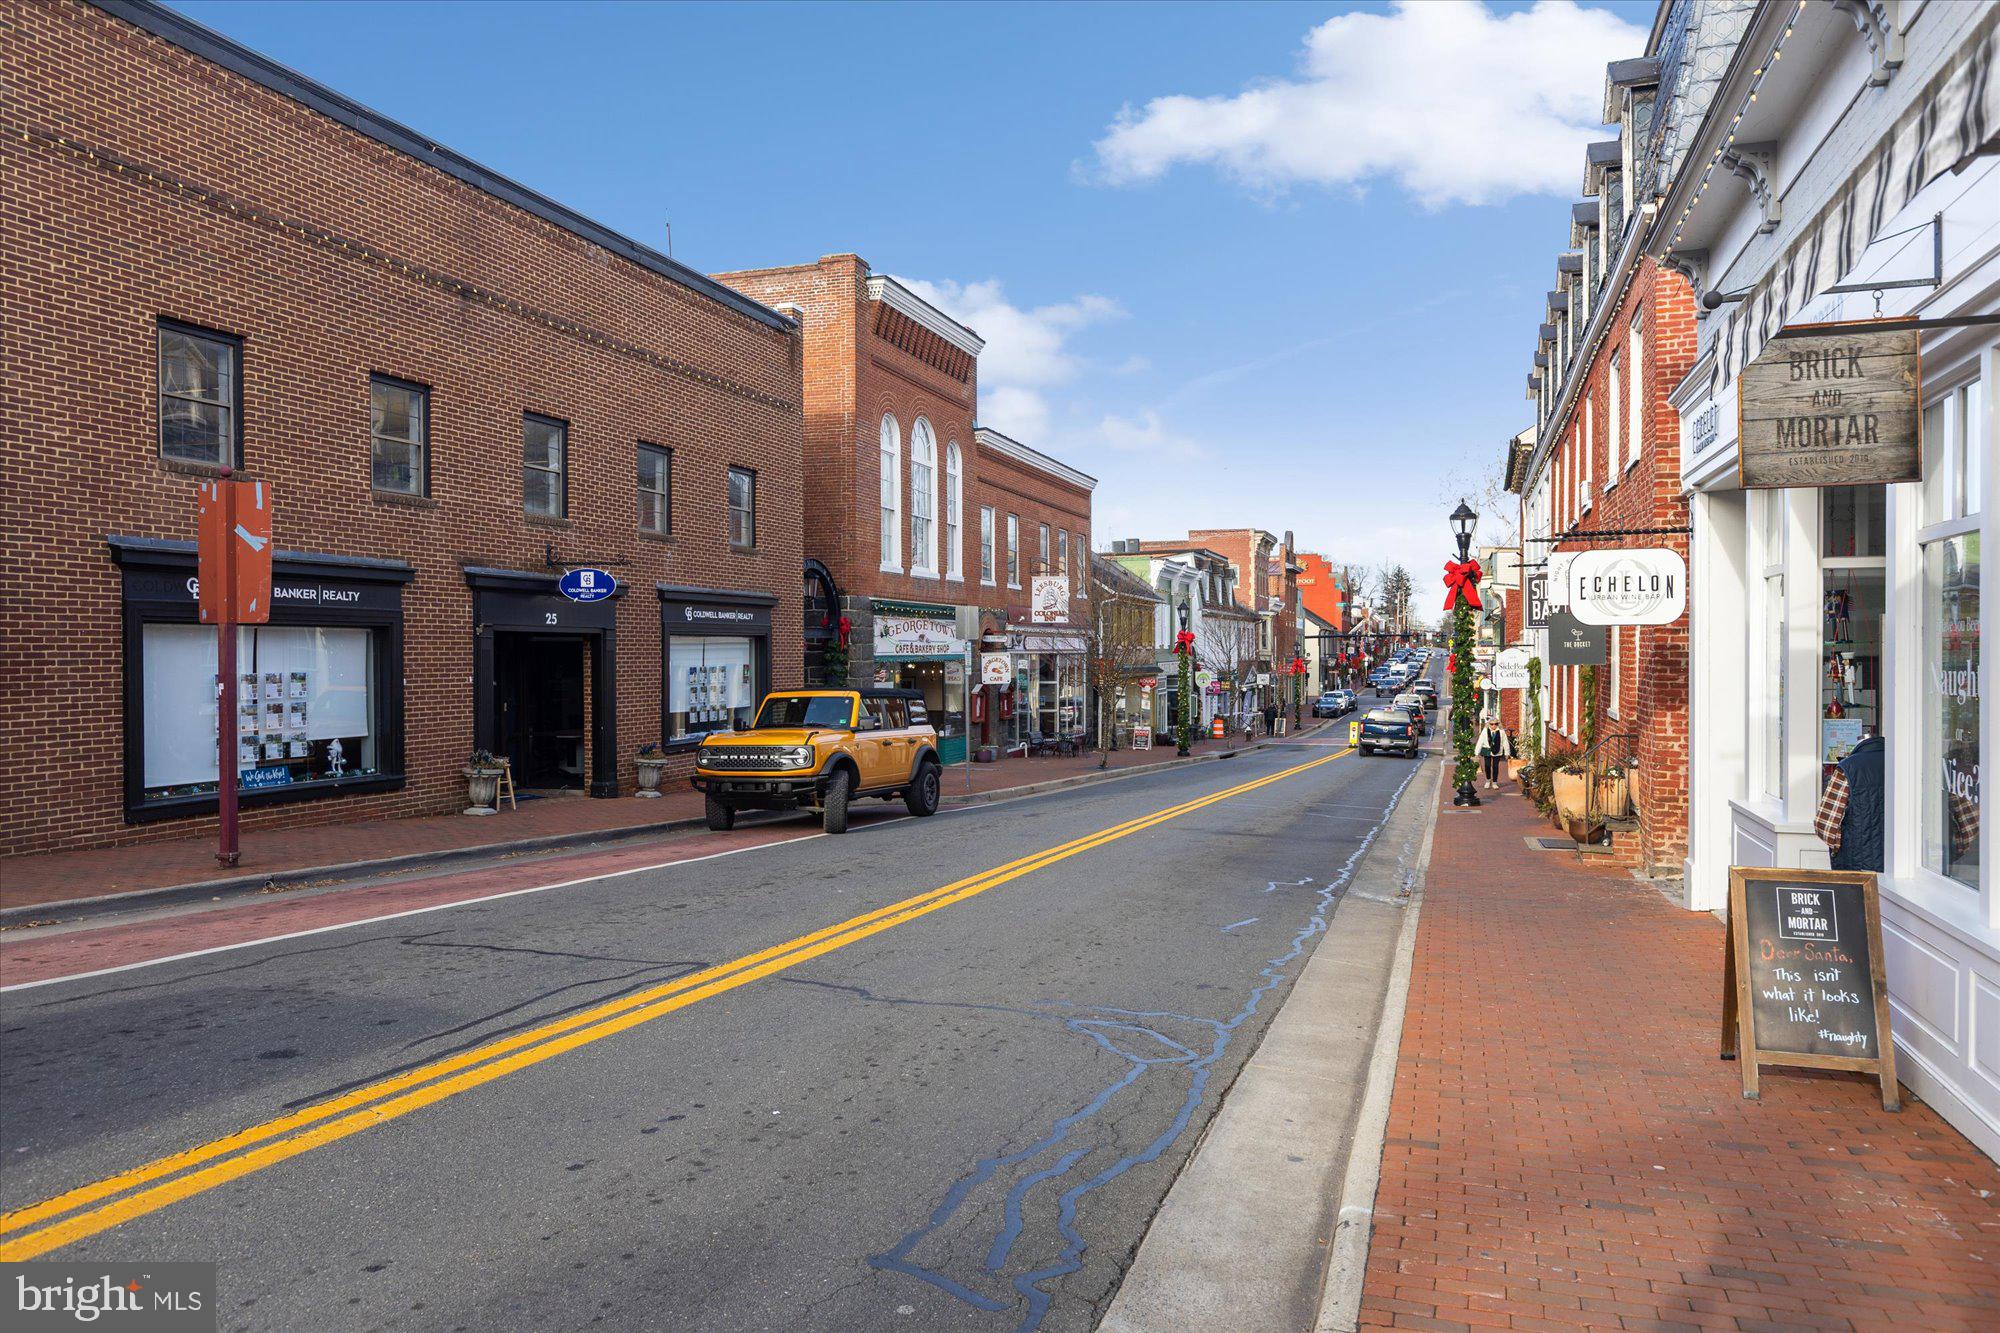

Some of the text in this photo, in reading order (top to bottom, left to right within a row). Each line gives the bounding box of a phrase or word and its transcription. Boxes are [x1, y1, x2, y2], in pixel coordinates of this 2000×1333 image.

[1789, 347, 1865, 381] BRICK
[1813, 389, 1842, 407] AND
[1777, 413, 1879, 448] MORTAR
[1789, 456, 1844, 466] ESTABLISHED
[274, 587, 317, 600] BANKER
[322, 590, 360, 602] REALTY
[1034, 580, 1066, 597] LEESBURG
[1580, 575, 1674, 600] ECHELON
[1591, 593, 1618, 601] URBAN
[545, 613, 558, 625] 25
[693, 610, 718, 619] COLDWELL
[718, 611, 736, 619] BANKER
[887, 619, 956, 638] GEORGETOWN
[936, 644, 950, 654] SHOP
[983, 657, 1010, 674] GEORGETOWN
[1500, 670, 1525, 678] Coffee
[1791, 892, 1821, 906] BRICK
[1800, 907, 1813, 915] AND
[1788, 916, 1828, 931] MORTAR
[1804, 942, 1854, 964] Santa,
[1772, 967, 1841, 982] This isn't
[1762, 986, 1860, 1004] what it looks
[1788, 1006, 1820, 1024] like!
[1817, 1028, 1867, 1049] #naughty
